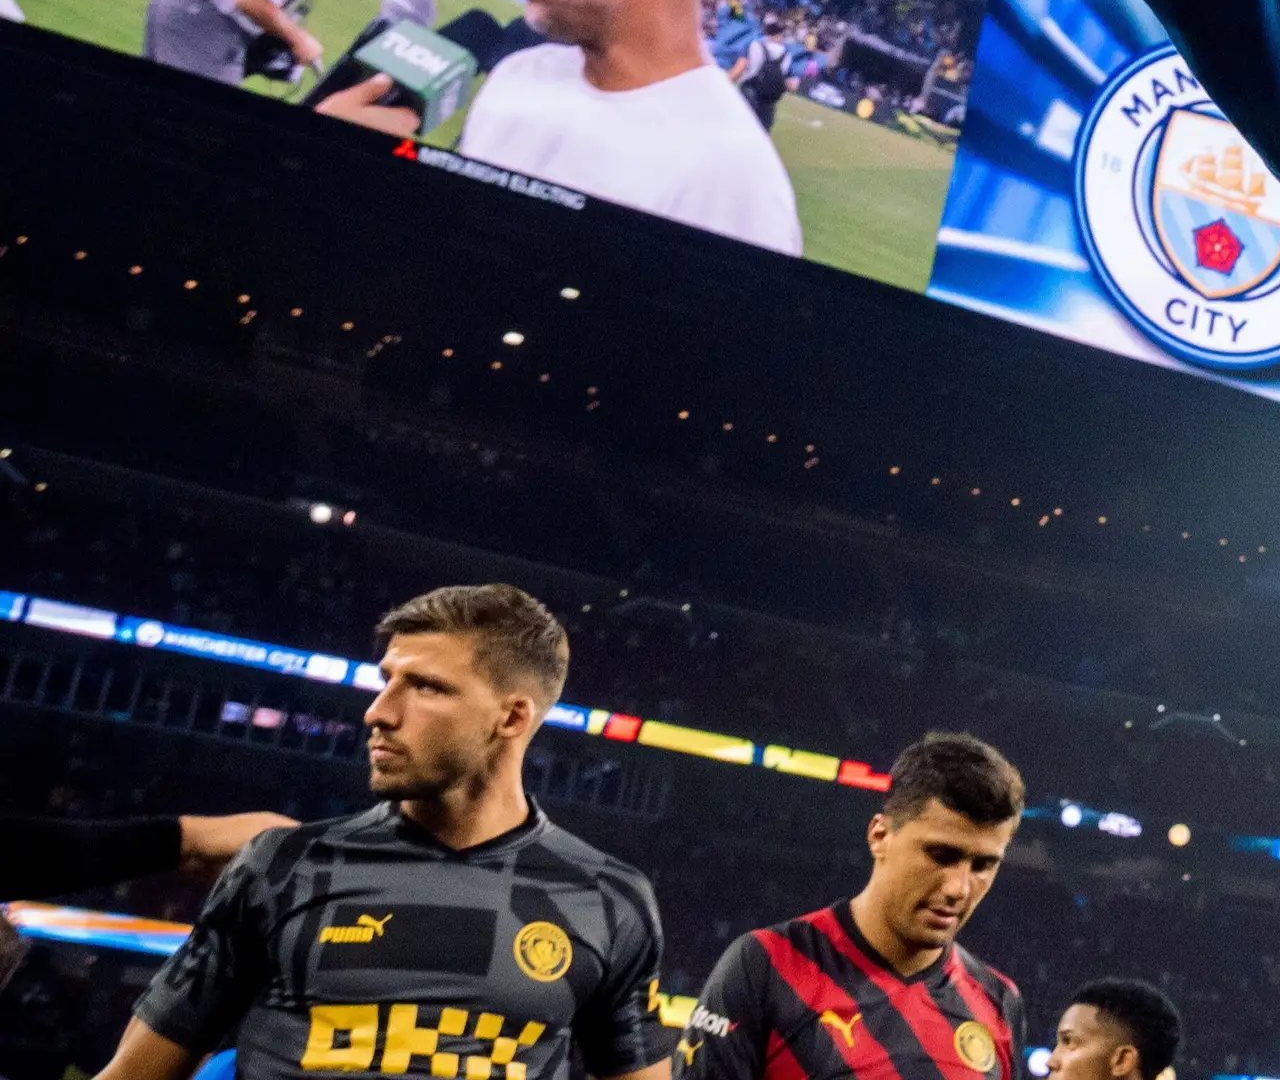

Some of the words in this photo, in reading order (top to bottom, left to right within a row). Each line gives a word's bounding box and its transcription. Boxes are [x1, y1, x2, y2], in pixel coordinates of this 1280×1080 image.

[1165, 297, 1248, 343] CITY
[318, 925, 375, 944] PUMA
[300, 1003, 547, 1080] OKX
